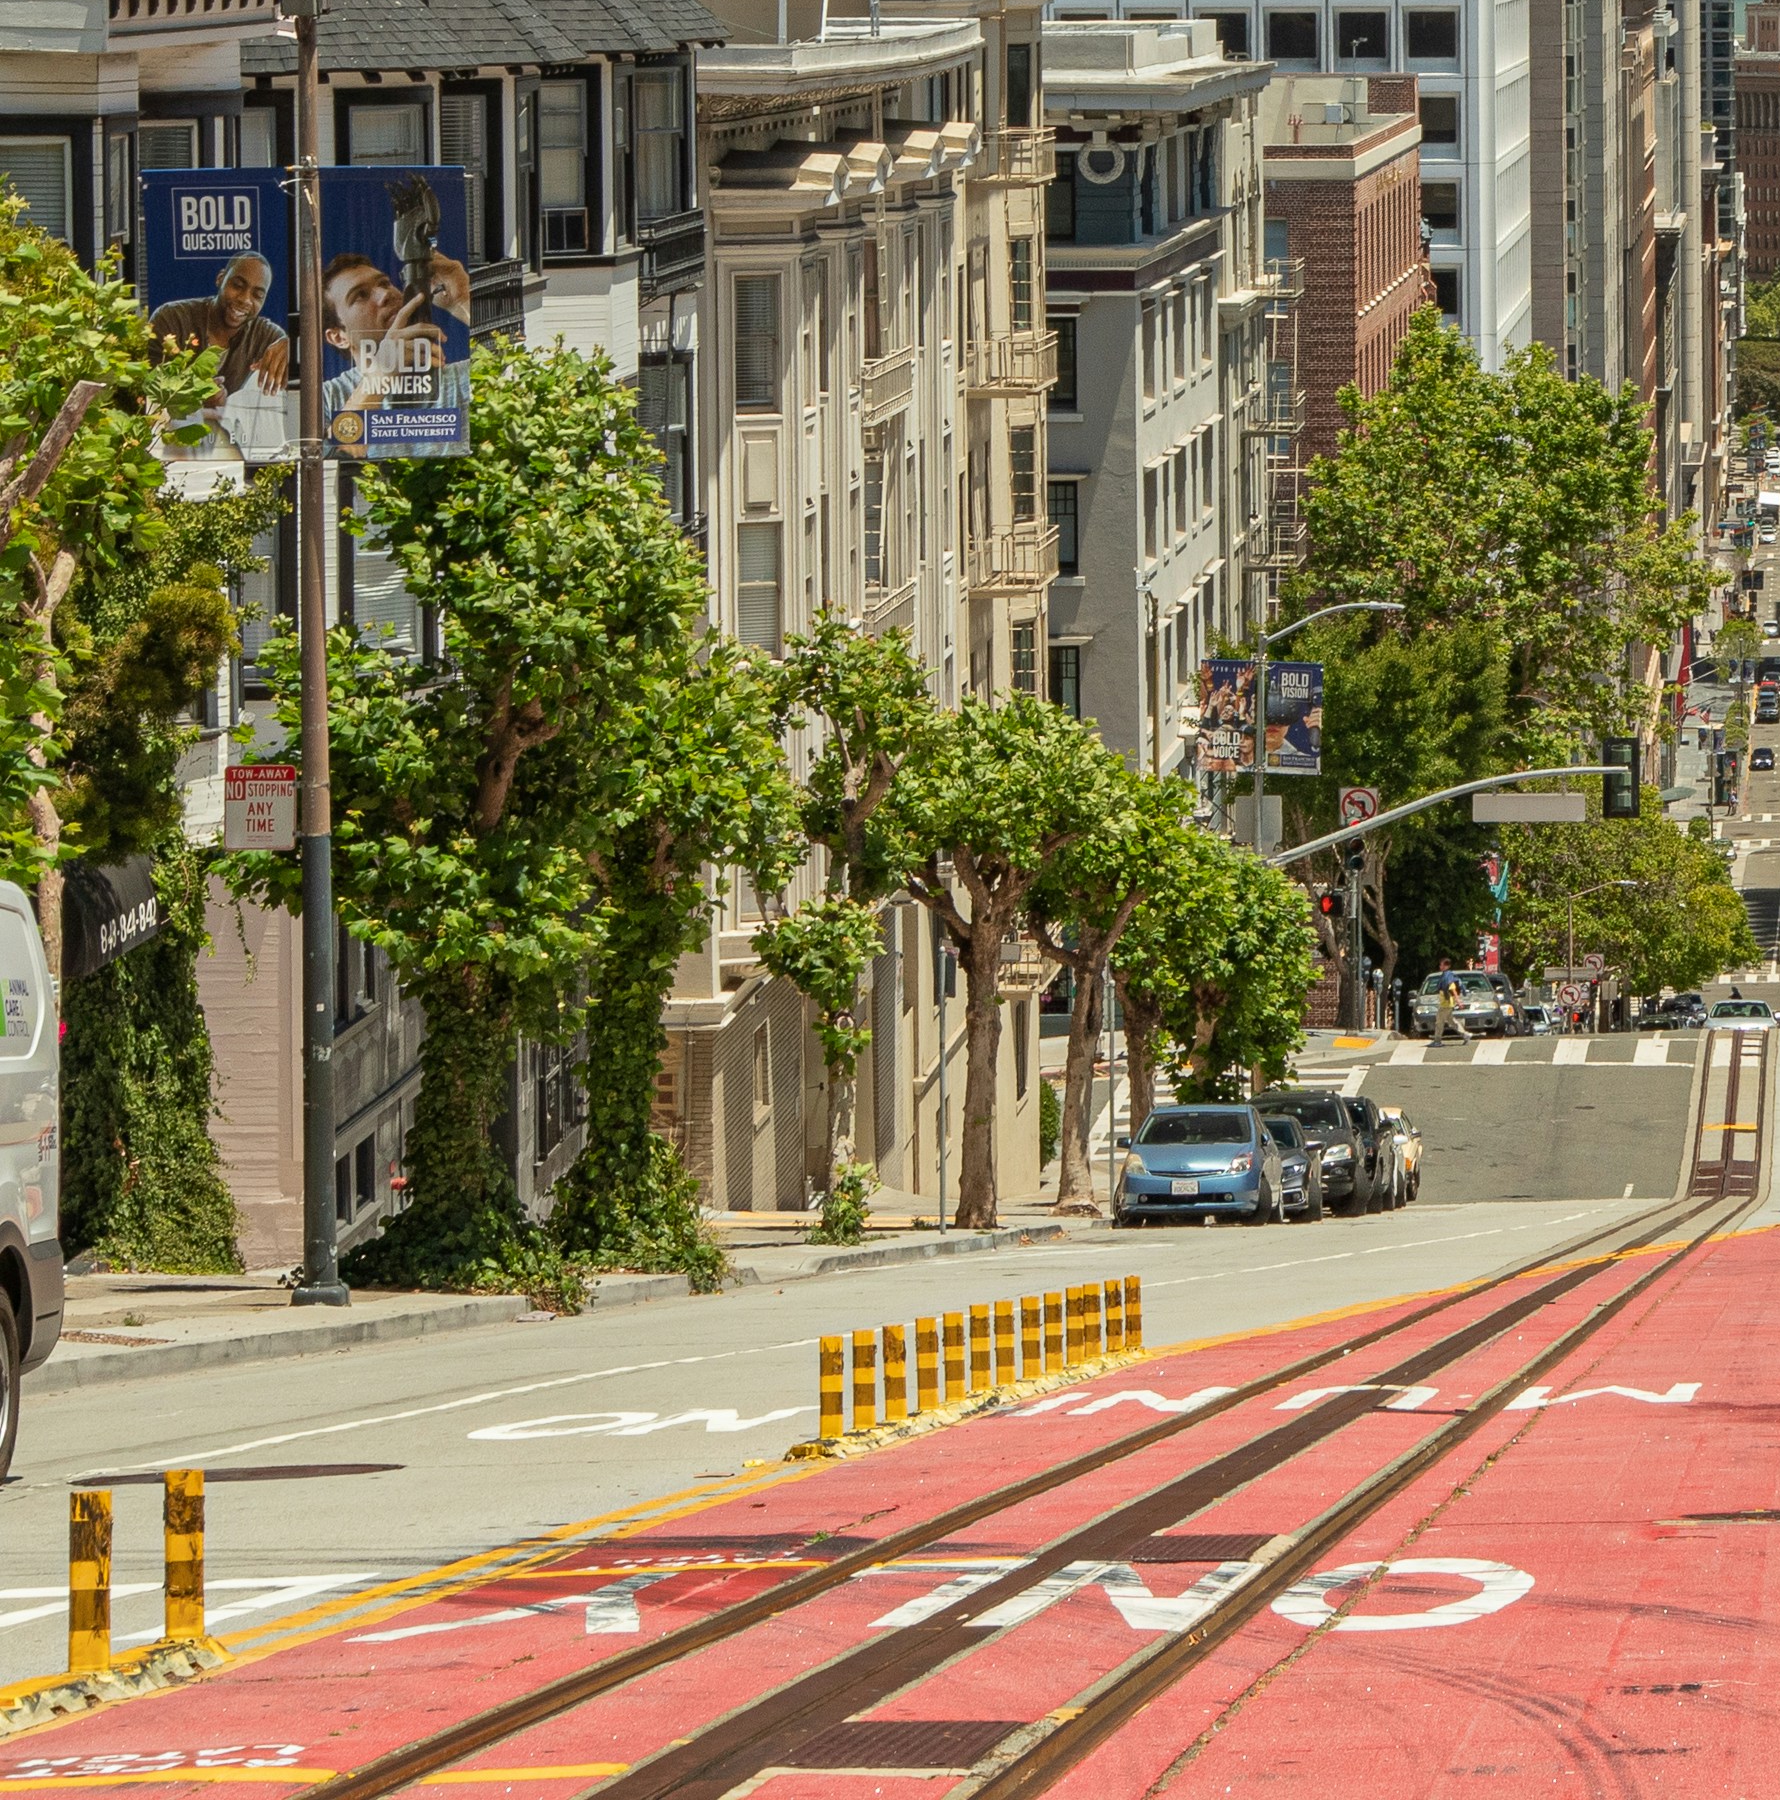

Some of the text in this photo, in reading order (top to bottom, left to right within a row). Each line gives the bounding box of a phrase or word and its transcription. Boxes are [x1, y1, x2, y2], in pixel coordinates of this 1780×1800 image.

[181, 195, 251, 231] BOLD
[182, 233, 252, 251] QUESTIONS
[360, 338, 432, 373] BOLD
[361, 374, 432, 394] ANSWERS
[1281, 672, 1310, 687] BOLD
[1281, 687, 1309, 699] VISION
[1212, 732, 1241, 746] BOLD
[1213, 746, 1240, 759] VOICE
[231, 768, 289, 779] TOW-AWAY
[226, 780, 293, 799] NO STOPPING
[247, 802, 274, 816] ANY
[245, 819, 275, 832] TIME
[8, 979, 29, 996] ANIMAL
[5, 999, 20, 1016] CARE
[8, 1020, 30, 1037] CONTROL
[985, 1382, 1705, 1416] MUNI
[341, 1557, 1536, 1644] ONLY
